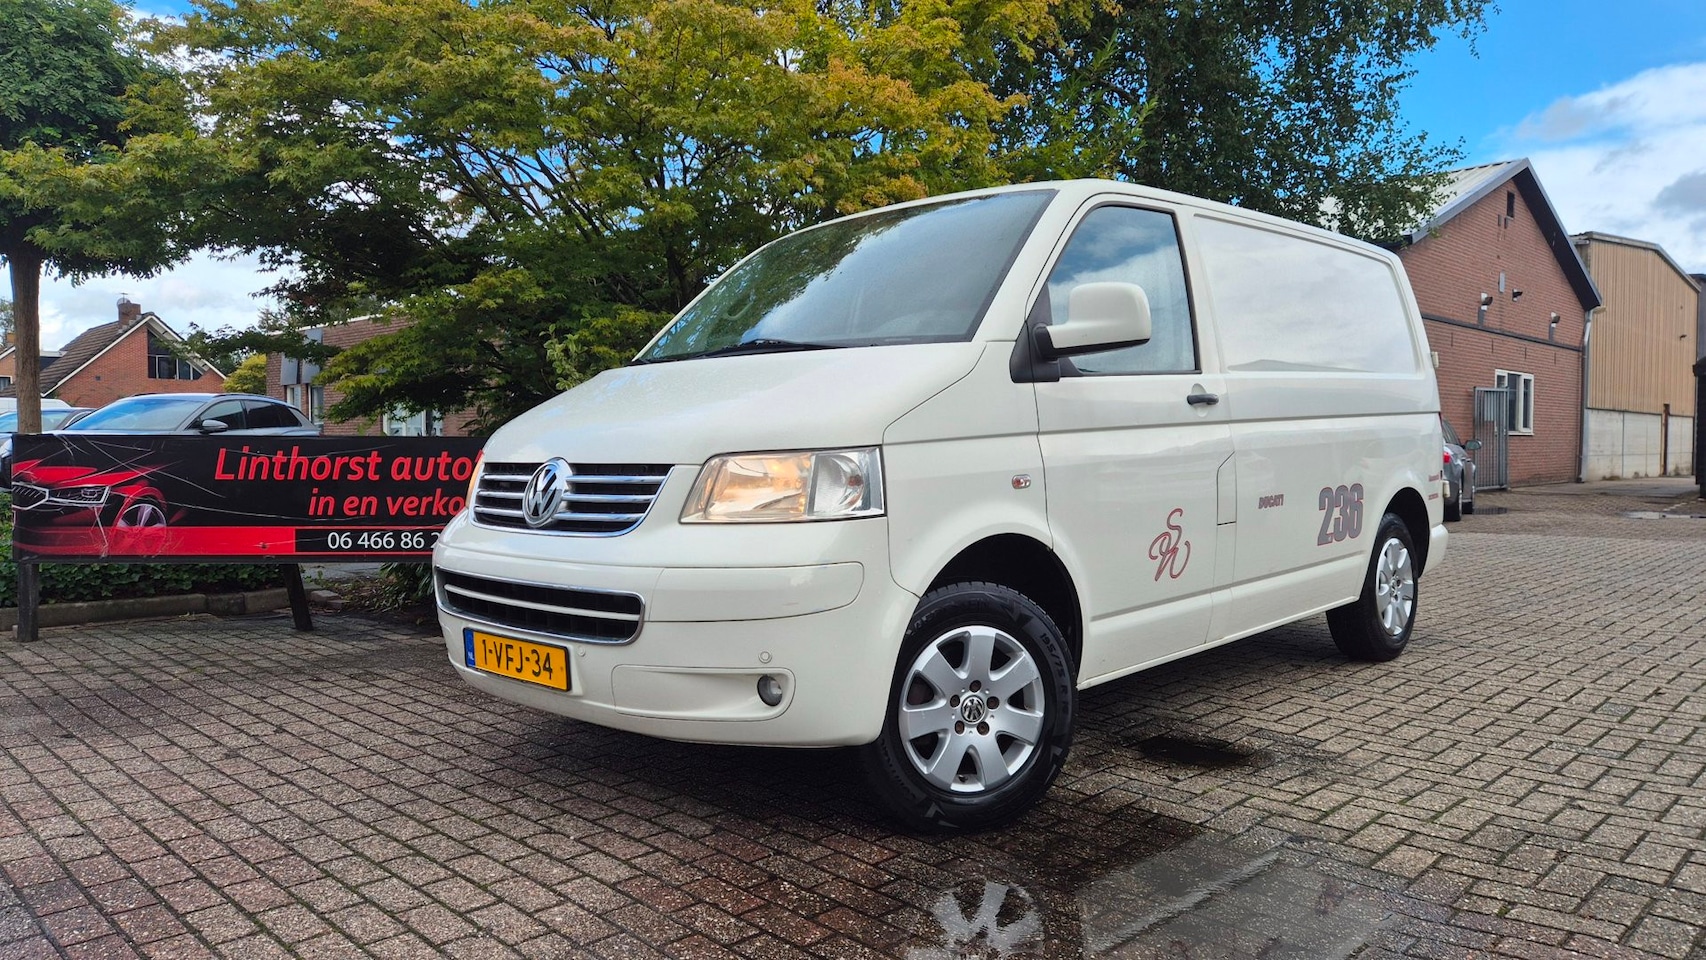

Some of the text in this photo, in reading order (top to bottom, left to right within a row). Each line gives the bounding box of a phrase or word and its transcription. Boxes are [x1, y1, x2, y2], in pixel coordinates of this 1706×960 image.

[214, 446, 383, 482] Linthorst
[308, 487, 465, 516] in en verko
[1258, 494, 1285, 509] DUCATI
[1317, 483, 1364, 546] 236
[327, 532, 351, 549] 06
[357, 532, 395, 549] 466
[400, 532, 425, 549] 86
[482, 639, 553, 680] 1-VFJ-34
[1039, 633, 1066, 678] 195/75
